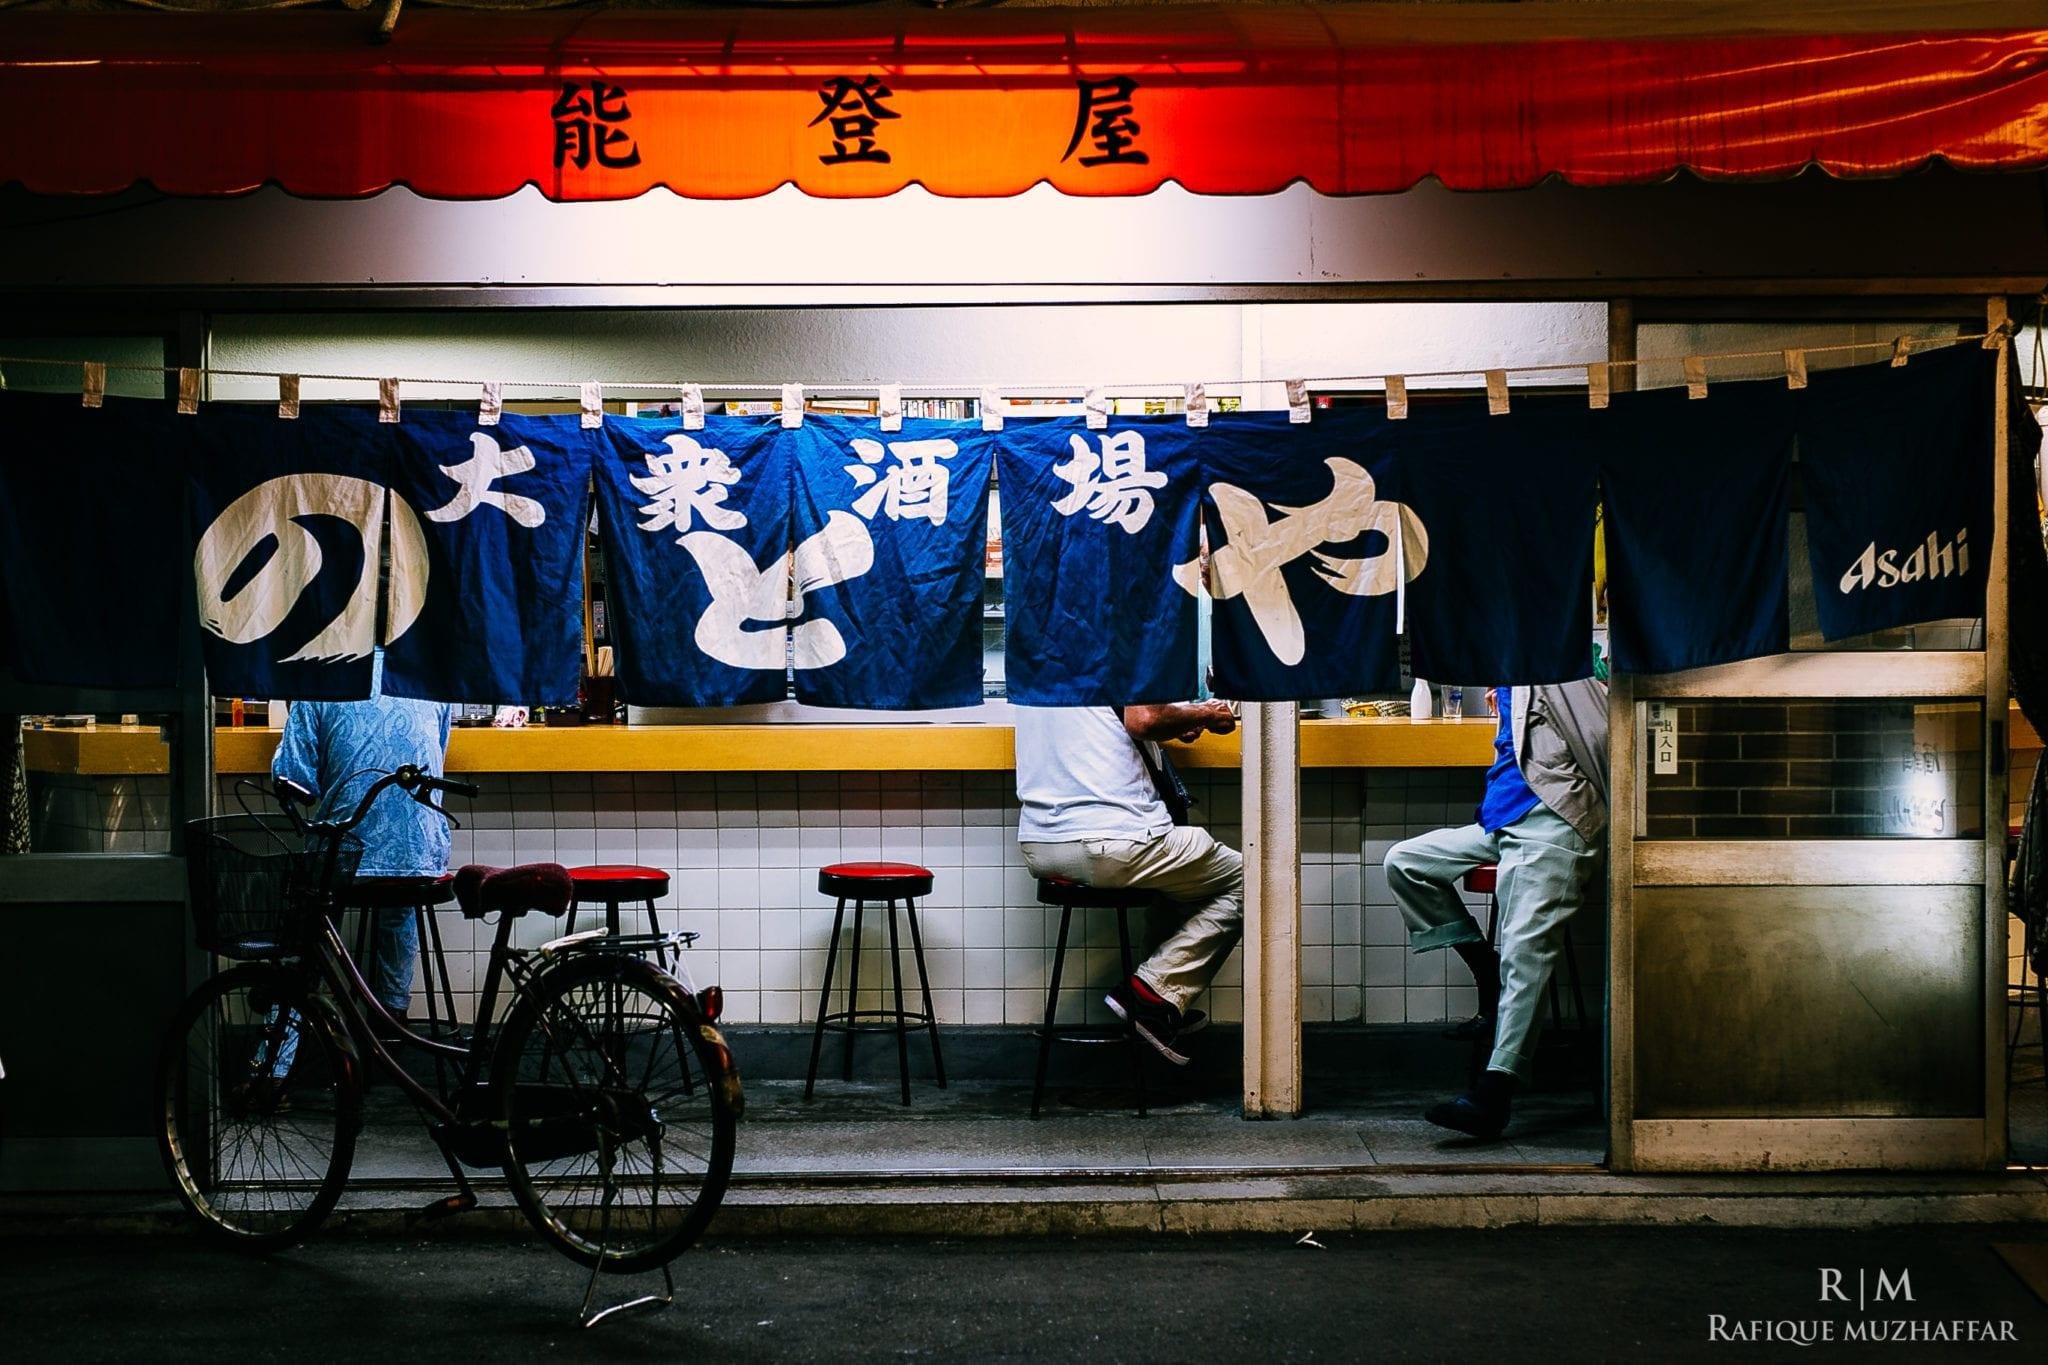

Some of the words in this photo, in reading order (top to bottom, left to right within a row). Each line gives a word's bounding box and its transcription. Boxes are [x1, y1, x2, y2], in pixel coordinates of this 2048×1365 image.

[550, 75, 1150, 170] 能登屋
[424, 430, 1168, 535] 大衆酒場
[194, 456, 1429, 672] のとや
[1840, 527, 1970, 595] Asahi
[1659, 719, 1673, 763] 出入口
